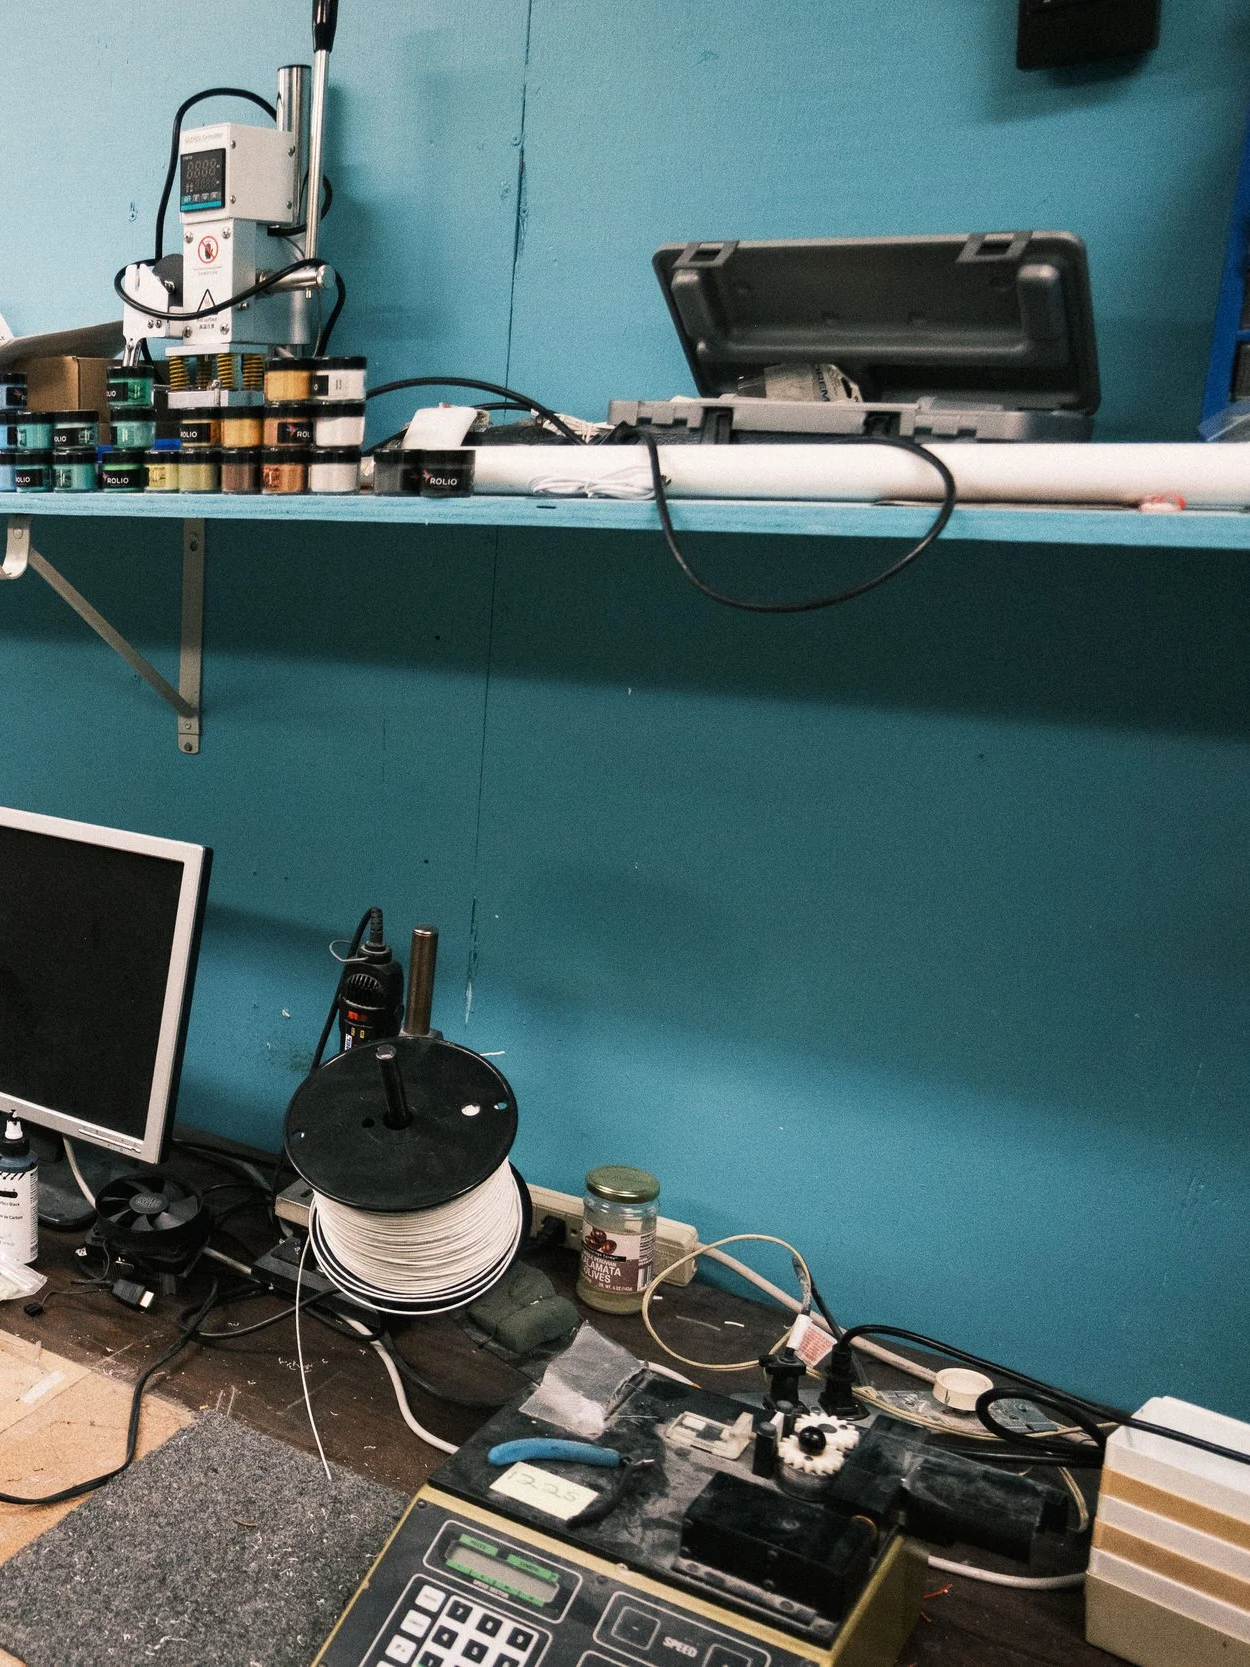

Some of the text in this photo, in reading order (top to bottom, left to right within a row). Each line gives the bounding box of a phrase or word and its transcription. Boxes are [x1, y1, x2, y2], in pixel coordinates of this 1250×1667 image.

[429, 477, 458, 486] ROLIO
[582, 1253, 621, 1277] ALAMATA
[583, 1265, 611, 1284] OLIVES
[456, 1607, 464, 1615] 7
[441, 1633, 450, 1642] 4
[662, 1635, 699, 1658] SPEED
